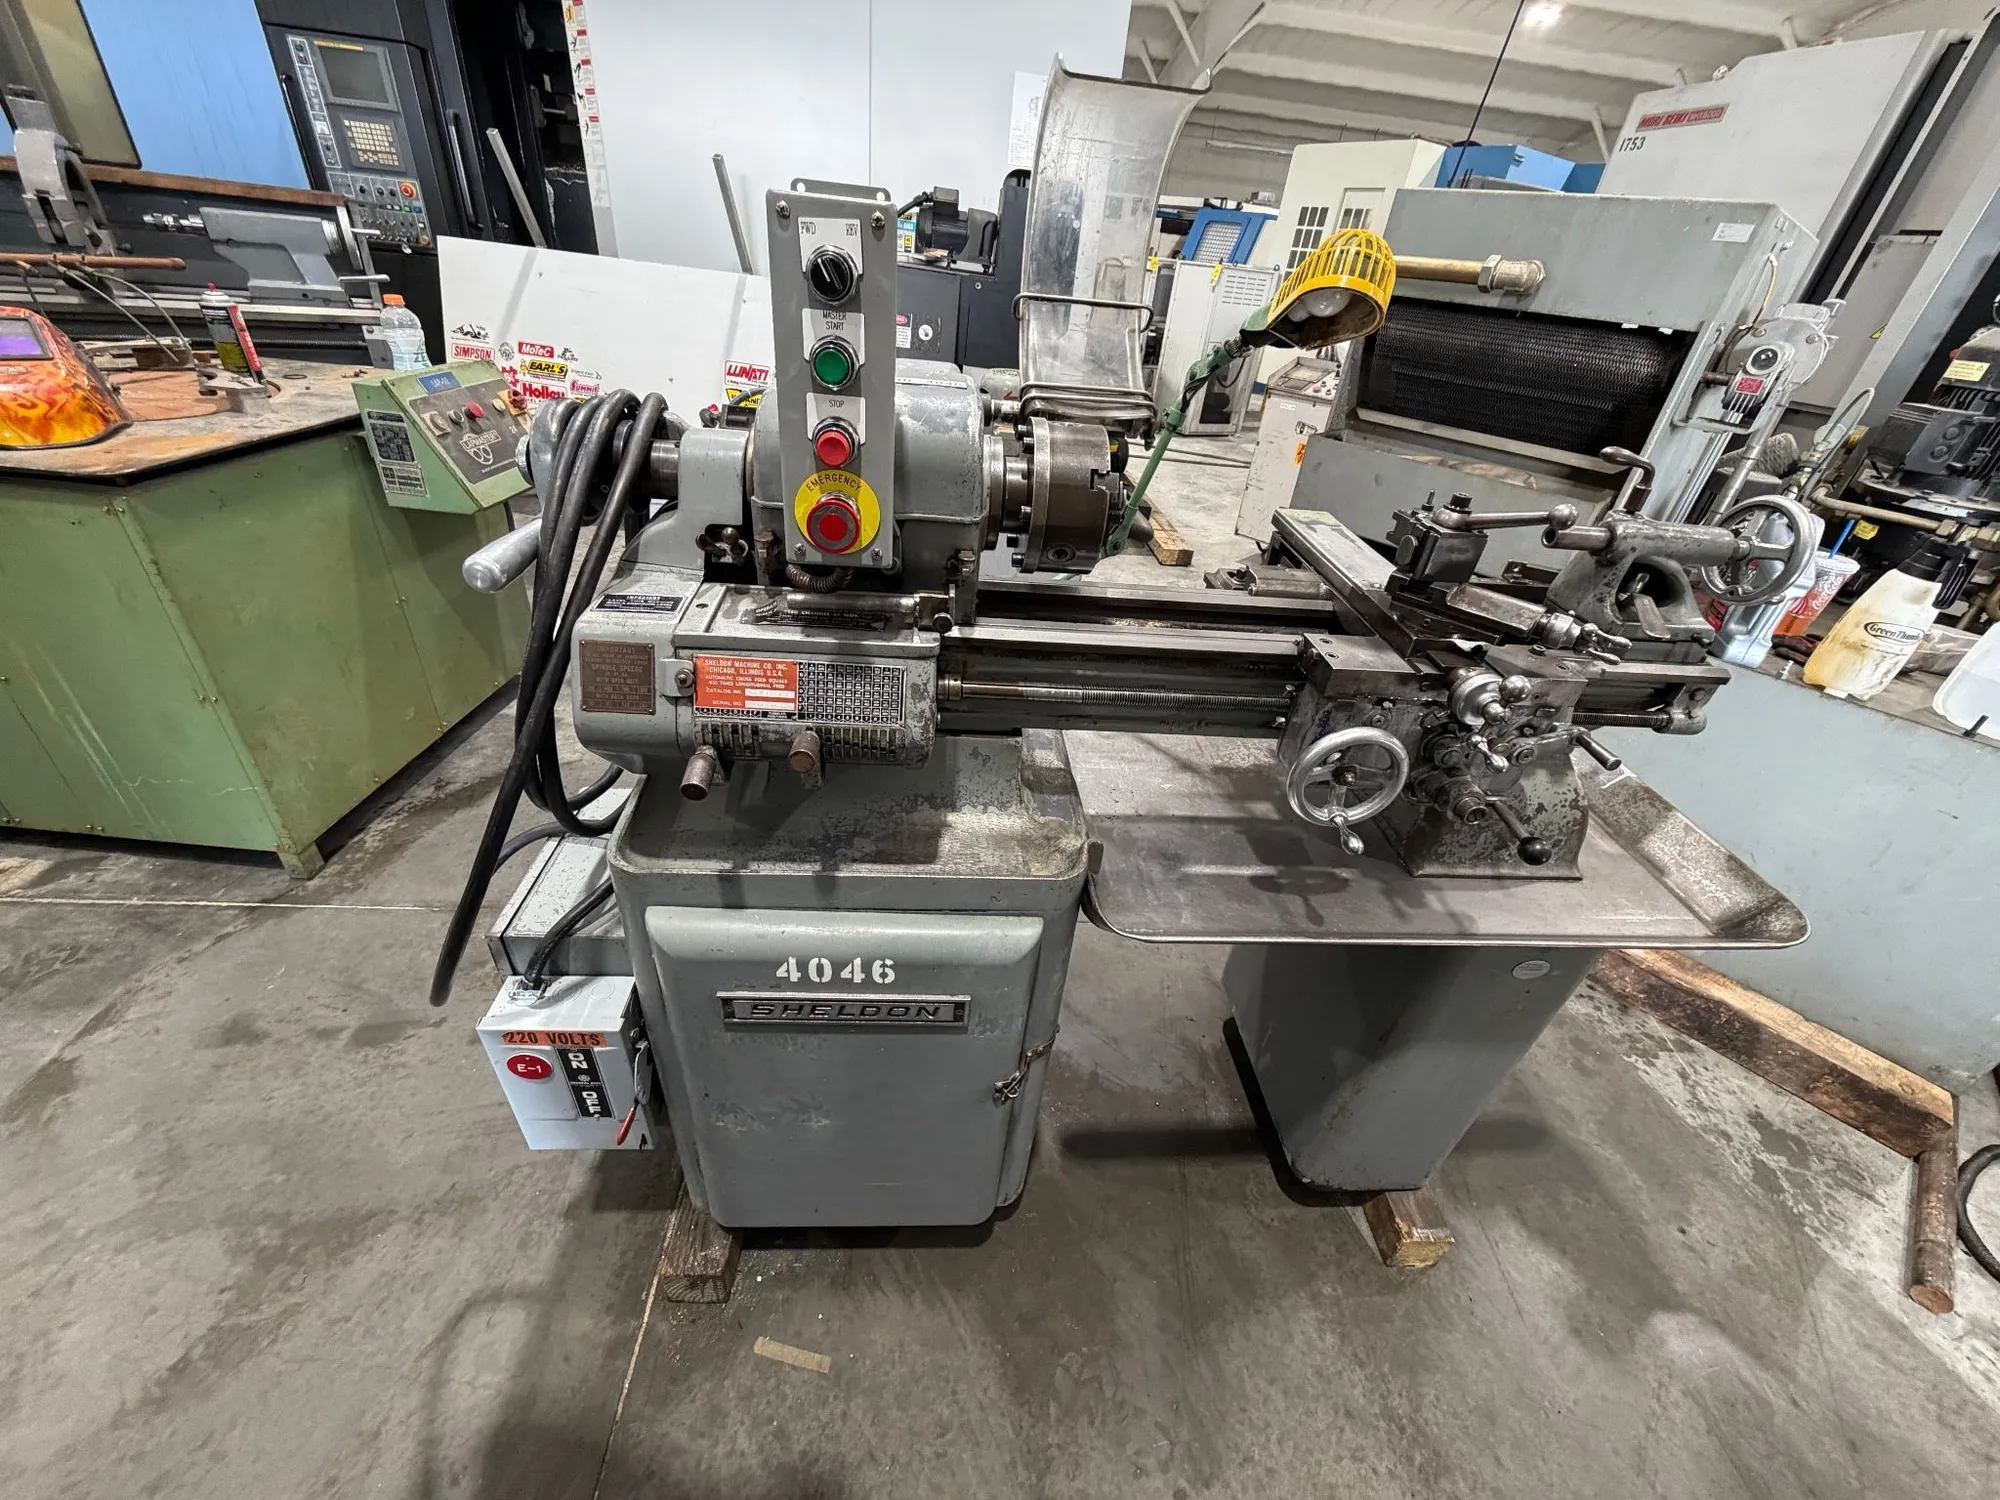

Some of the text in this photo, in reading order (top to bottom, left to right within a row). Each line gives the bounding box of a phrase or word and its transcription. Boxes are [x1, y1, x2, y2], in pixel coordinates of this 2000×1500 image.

[1618, 136, 1646, 152] 1753
[800, 222, 816, 235] FWD
[845, 223, 859, 237] REV
[822, 310, 847, 320] MASTER
[825, 321, 844, 331] START
[454, 346, 492, 360] SIMPSON
[726, 363, 769, 382] LUNATI
[828, 400, 845, 408] STOP
[806, 473, 862, 492] EMERGENCY
[704, 659, 732, 667] SHELDON
[734, 660, 761, 669] MACHINE
[775, 663, 788, 671] INC.
[739, 668, 764, 676] ILLINOIS
[766, 669, 784, 677] U.S.A.
[775, 956, 897, 985] 4046
[751, 1003, 941, 1019] SHELDON
[507, 1032, 601, 1046] 220 VOLTS
[568, 1052, 588, 1070] ON
[517, 1063, 542, 1074] E-1
[581, 1091, 602, 1114] OFF
